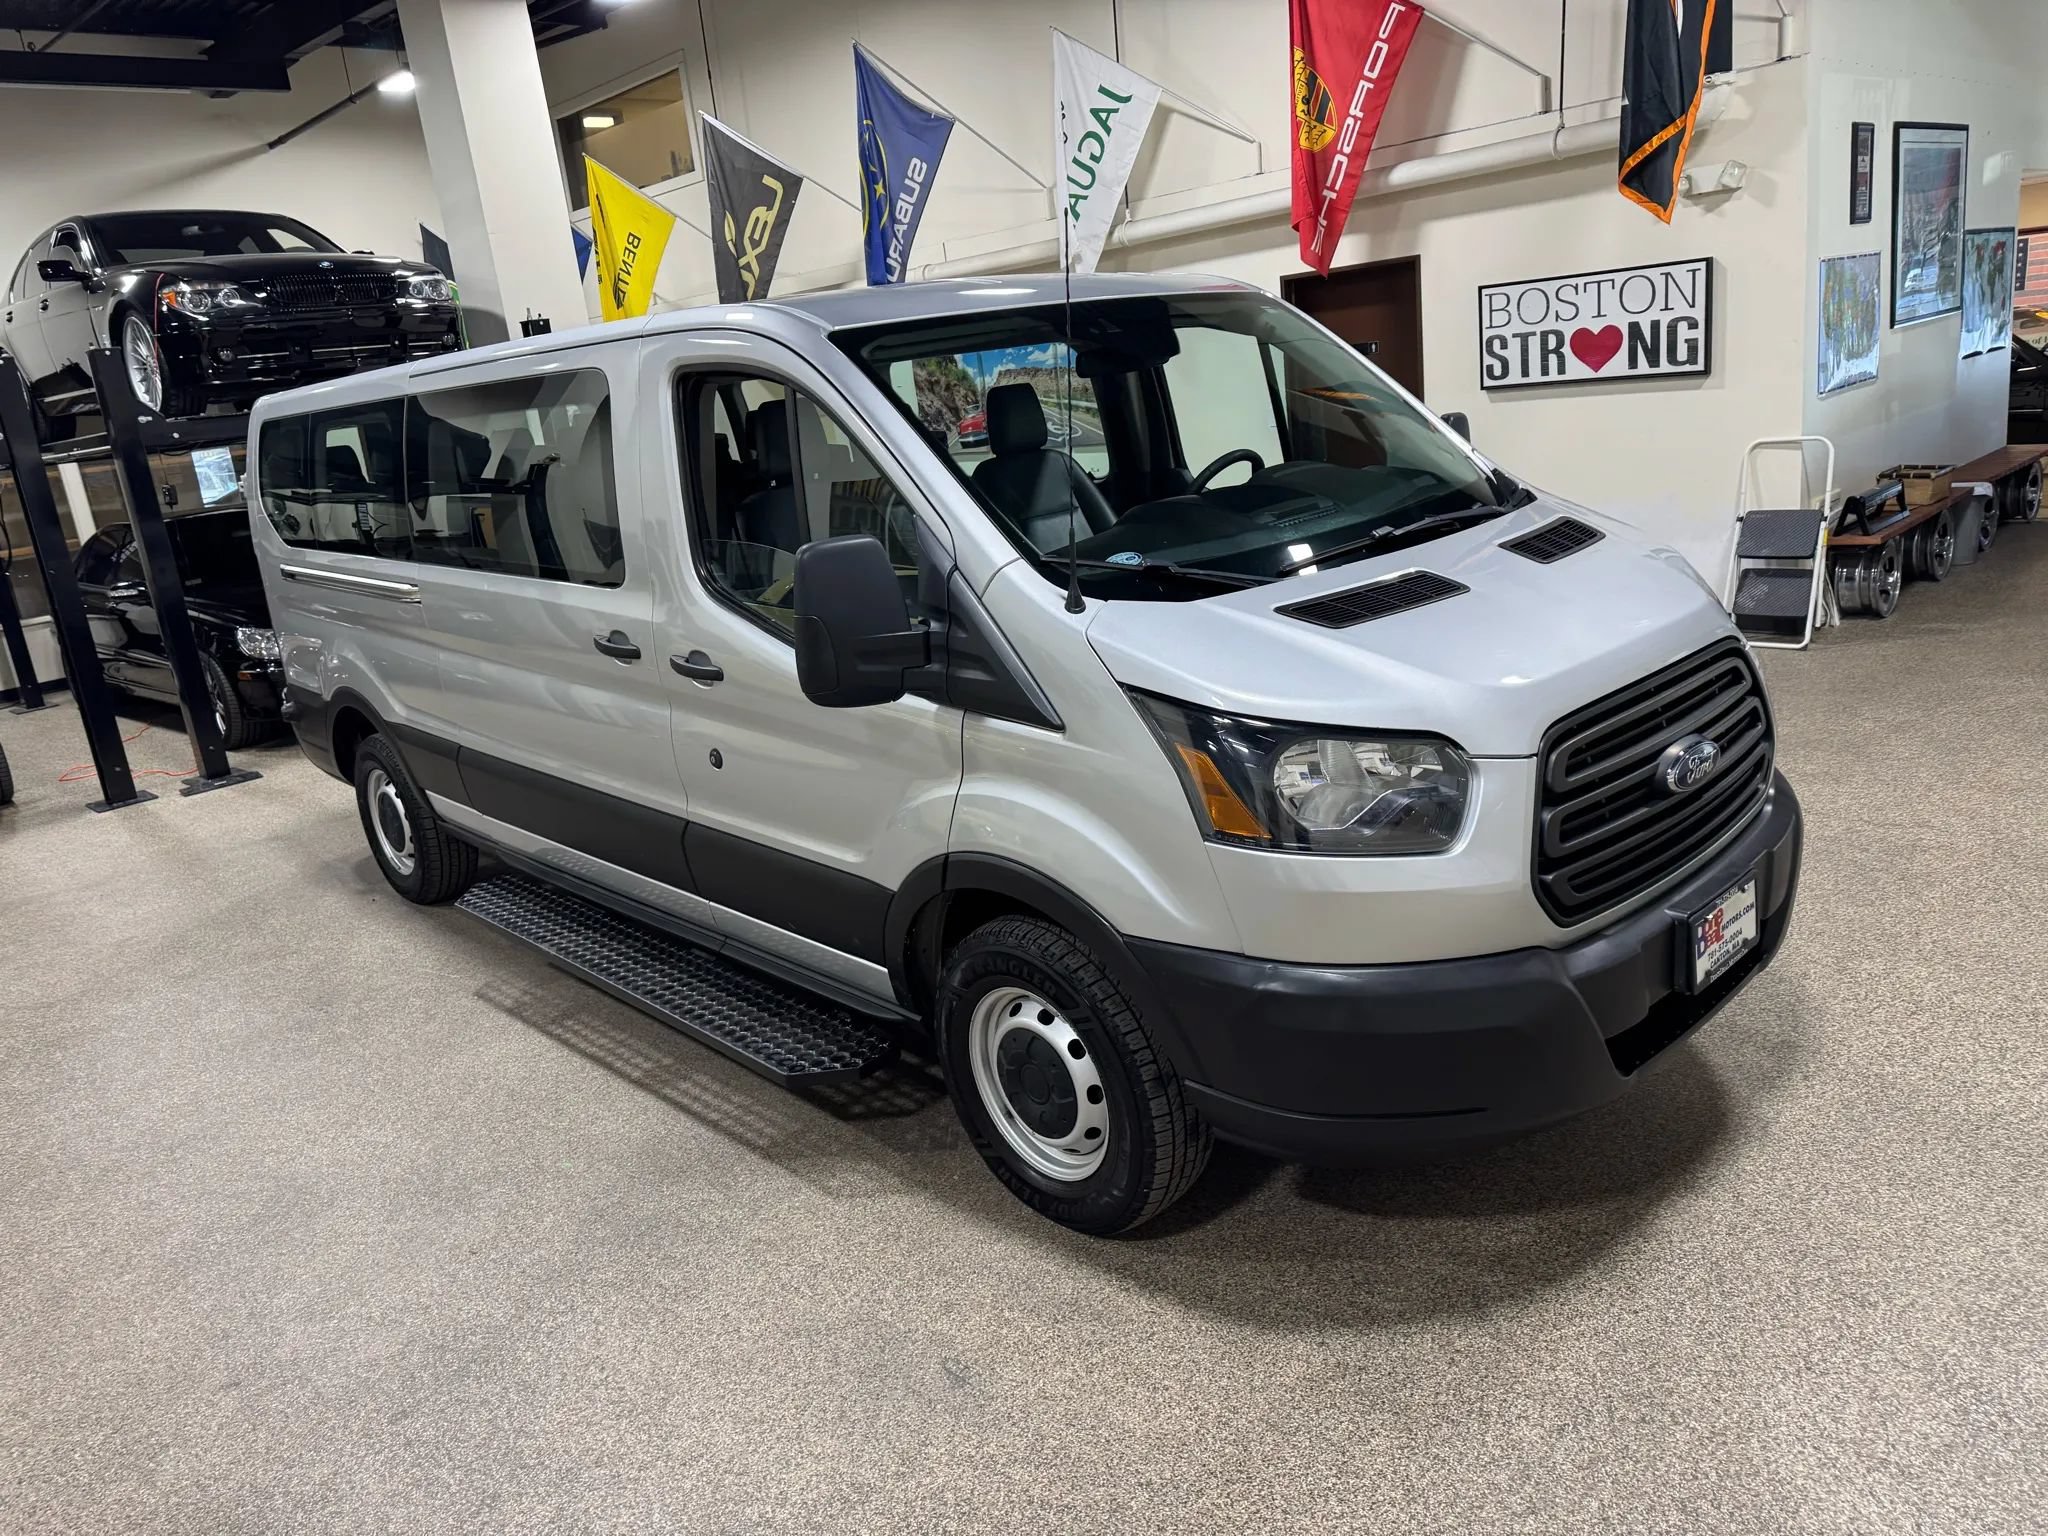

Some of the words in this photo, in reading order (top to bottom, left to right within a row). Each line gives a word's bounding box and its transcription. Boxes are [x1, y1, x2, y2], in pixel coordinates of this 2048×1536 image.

[1484, 268, 1702, 329] BOSTON
[1687, 749, 1717, 783] Ford
[1721, 901, 1755, 932] MOTORS.COM
